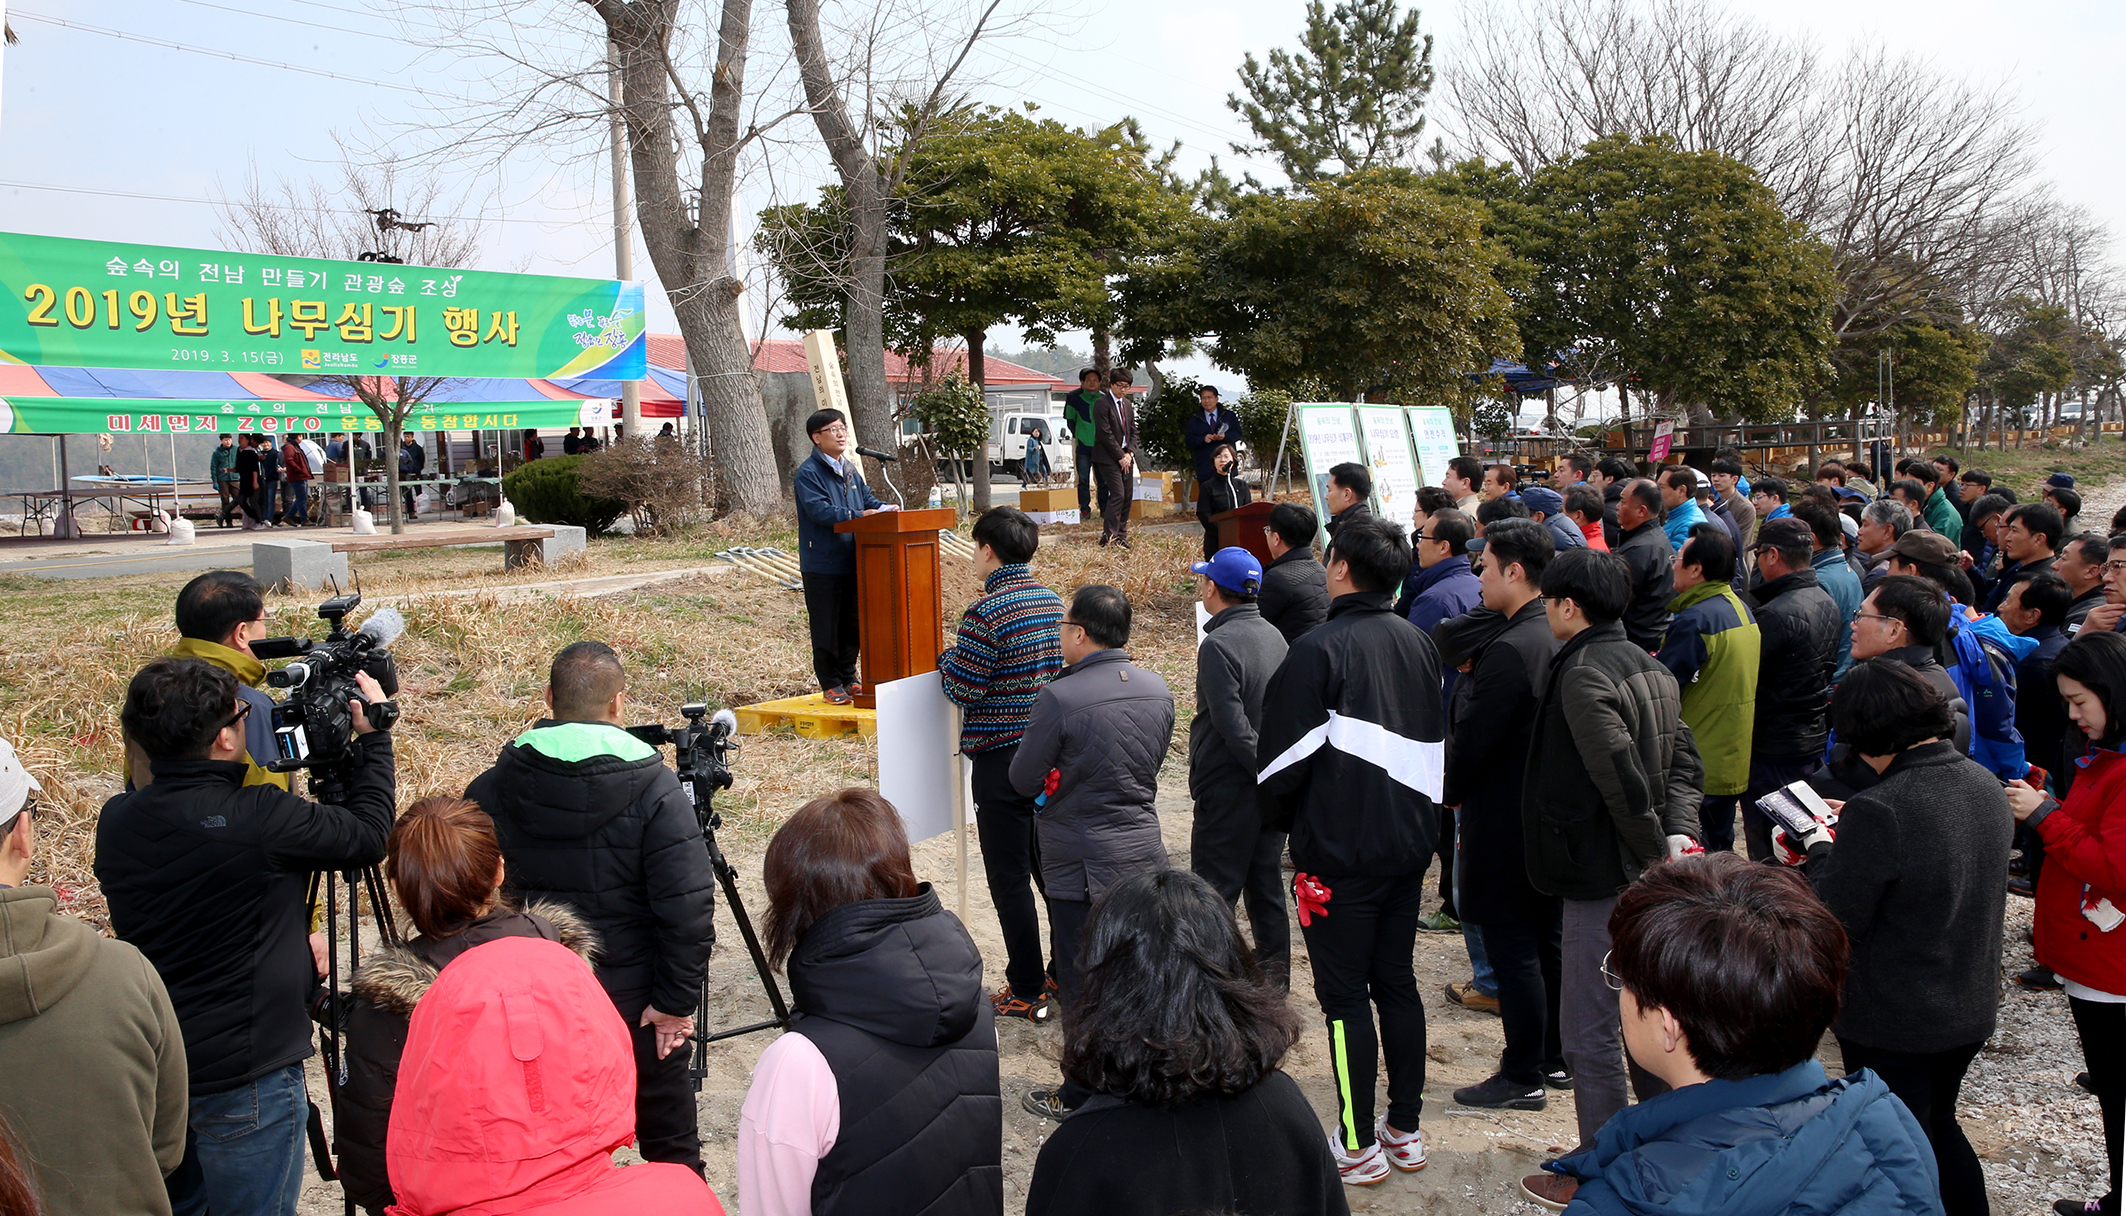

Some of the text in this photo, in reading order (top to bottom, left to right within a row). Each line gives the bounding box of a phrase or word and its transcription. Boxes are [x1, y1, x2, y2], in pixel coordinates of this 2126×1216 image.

[106, 255, 460, 299] 숲속의 전남 만들기 관광숲 조성
[24, 282, 520, 349] 2019년 나무심기 행사
[171, 348, 285, 366] 2019. 3. 15(금)
[322, 352, 359, 363] 전라남도
[390, 353, 418, 365] 장흥군
[220, 402, 287, 414] 숲속의
[315, 402, 353, 414] 전남
[107, 414, 519, 432] 미세먼지 zero 운동 동참합시다
